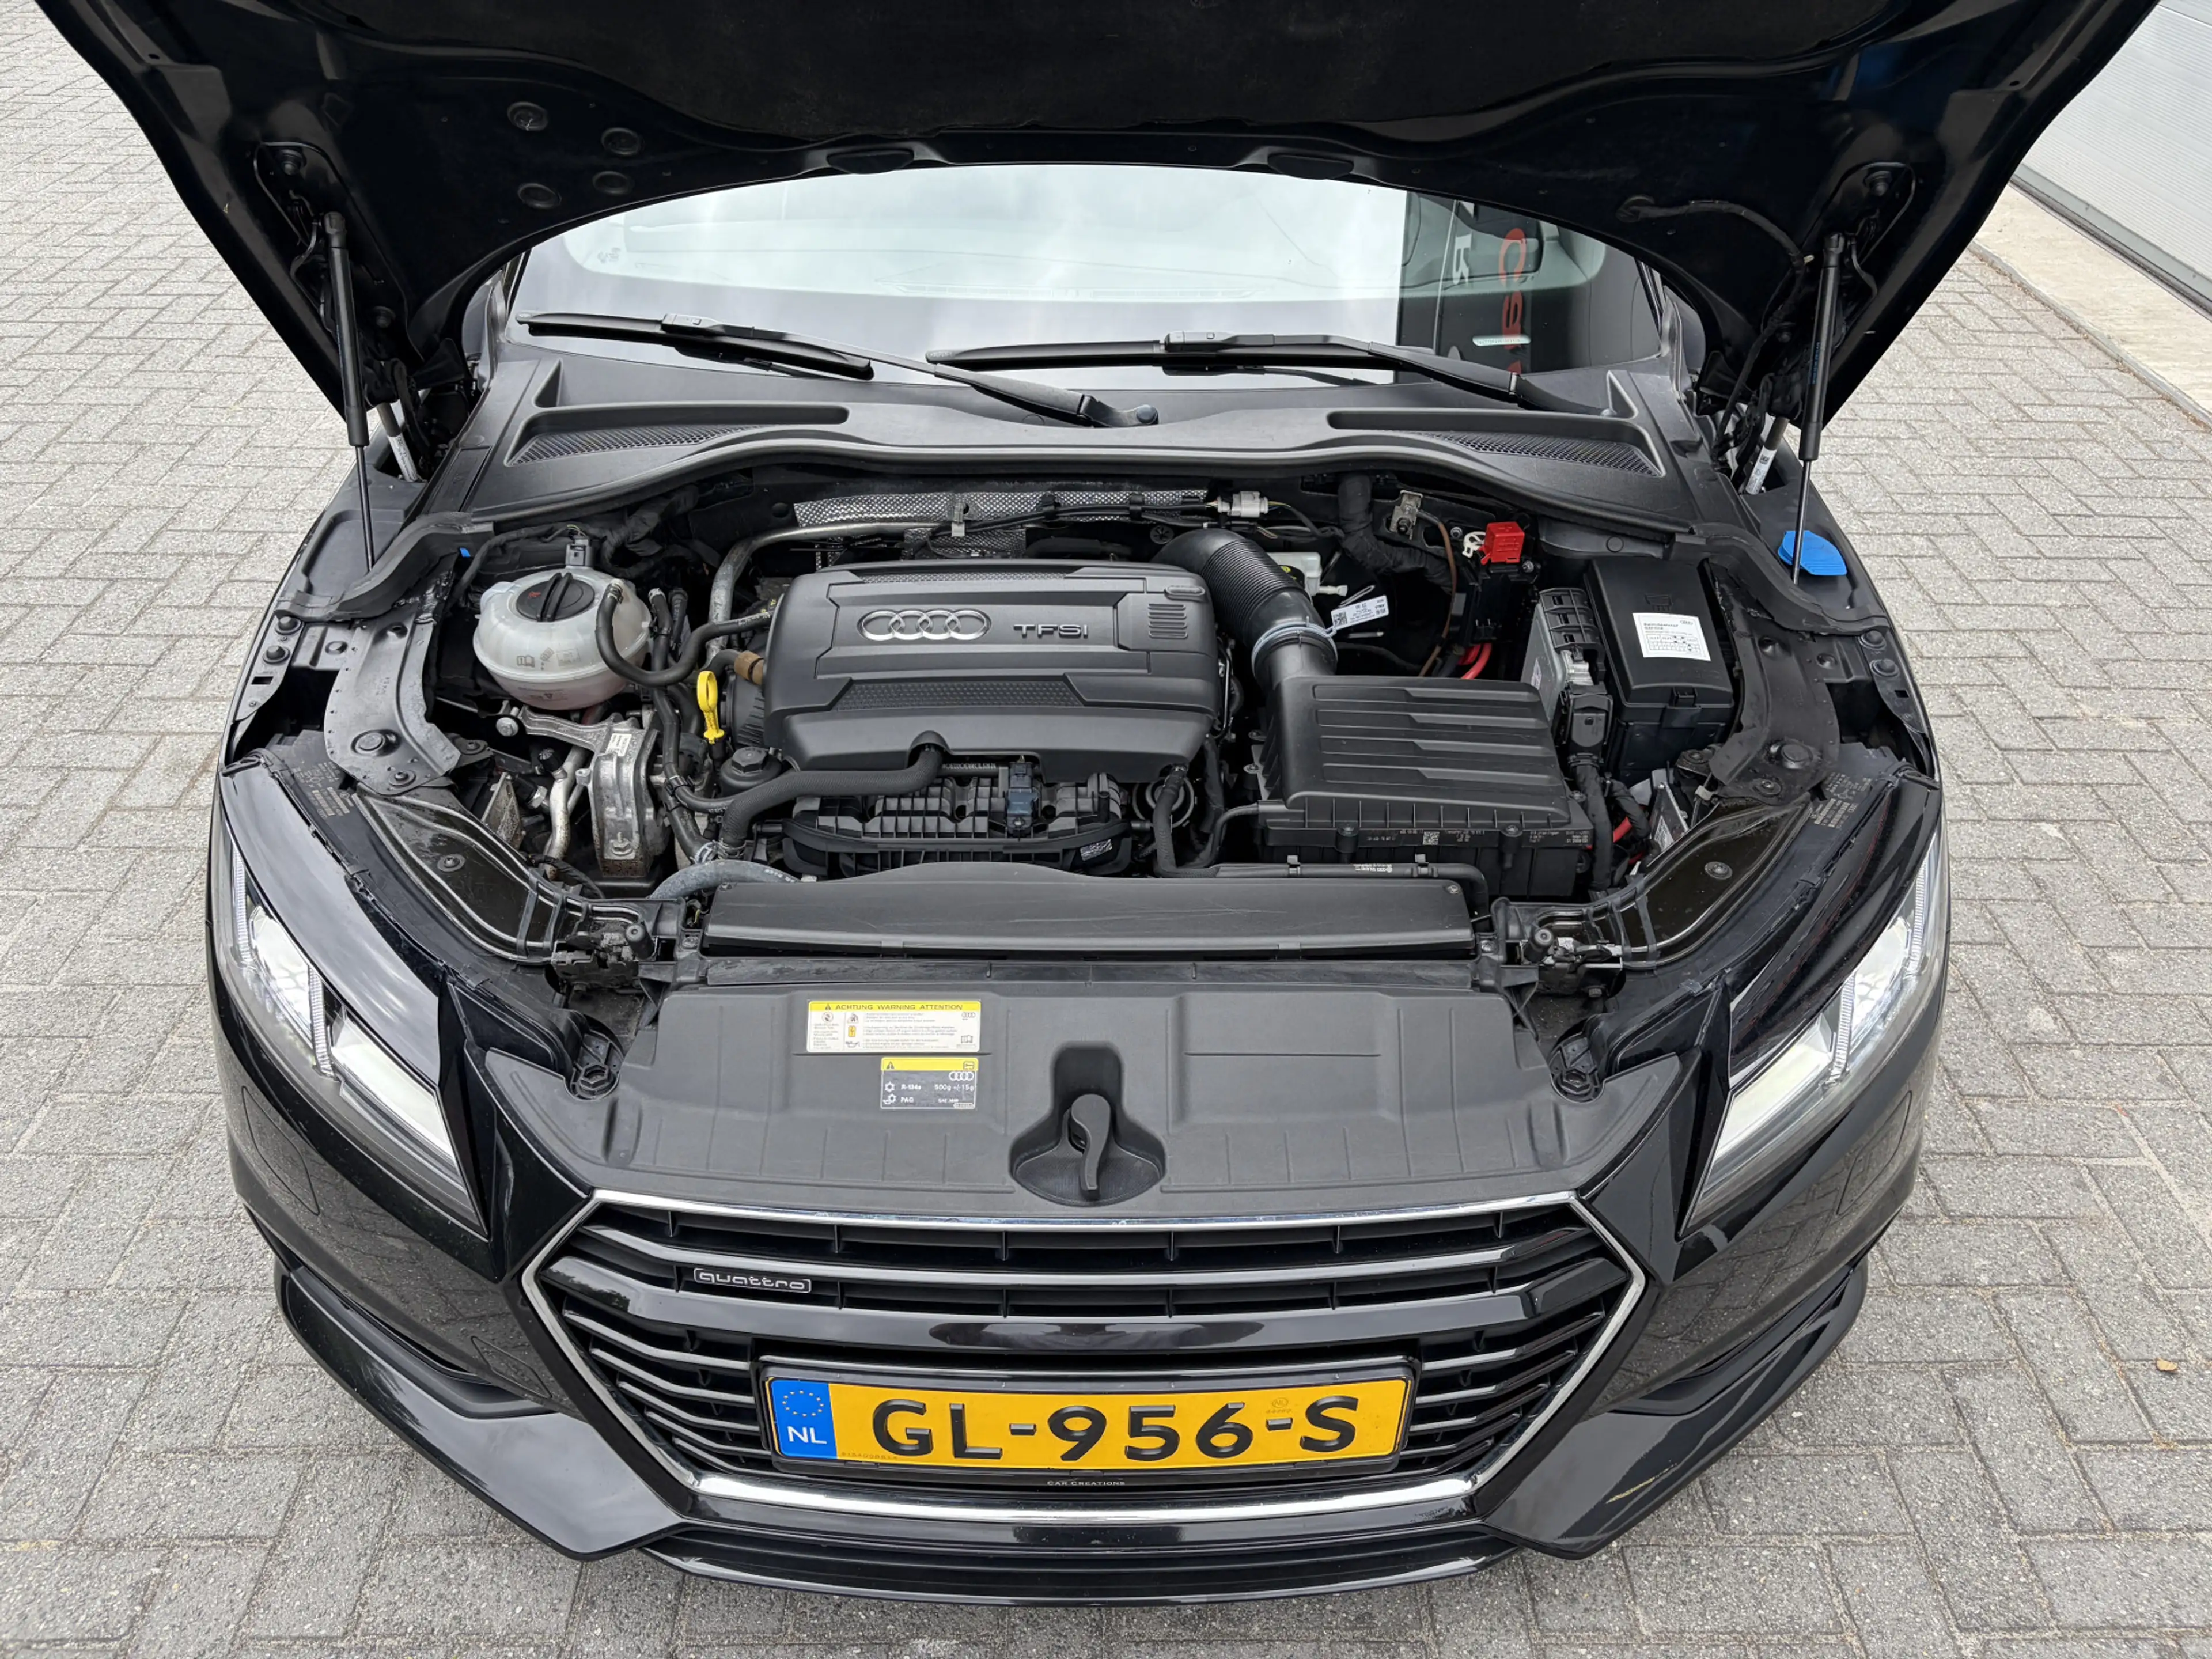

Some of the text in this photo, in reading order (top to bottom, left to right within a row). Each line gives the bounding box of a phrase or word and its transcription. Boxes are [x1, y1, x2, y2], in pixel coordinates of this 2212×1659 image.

[1014, 624, 1089, 638] TFSI
[699, 1271, 805, 1290] quattro
[787, 1426, 827, 1445] NL
[872, 1395, 1359, 1461] GL-956-S
